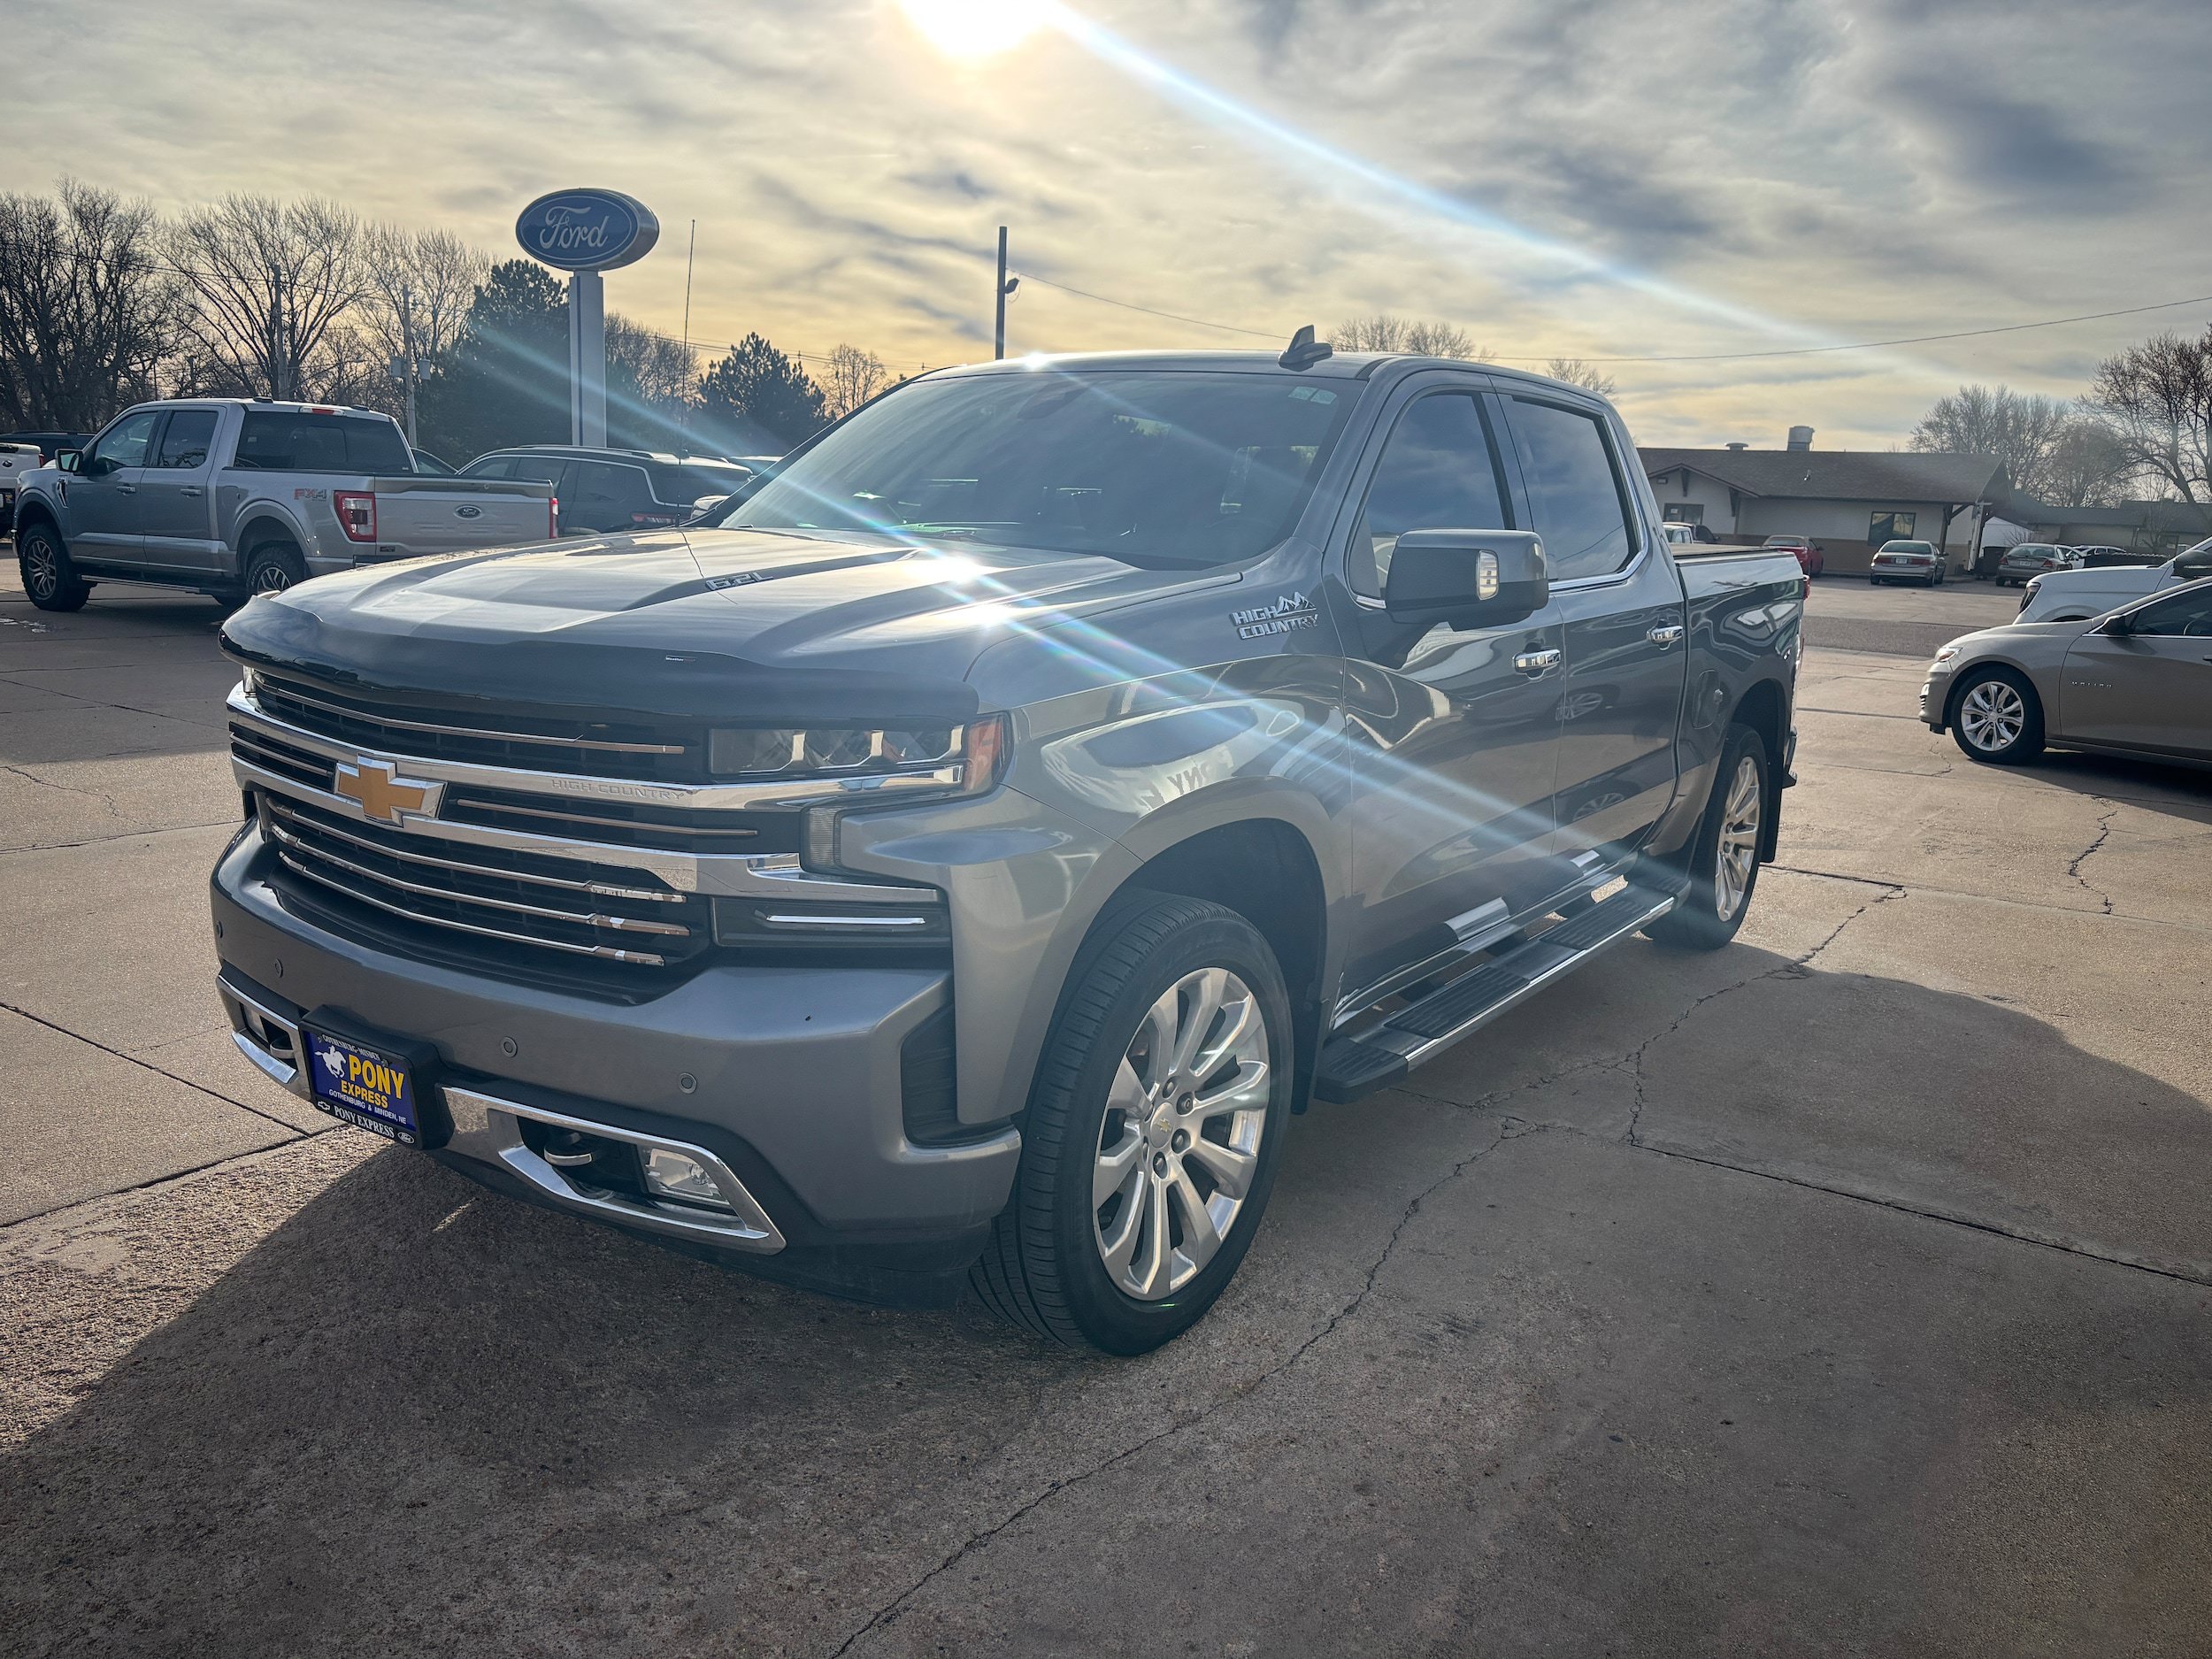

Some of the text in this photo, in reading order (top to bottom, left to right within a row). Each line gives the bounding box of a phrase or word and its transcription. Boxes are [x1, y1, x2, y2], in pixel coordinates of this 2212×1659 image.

[540, 206, 610, 249] Ford
[294, 488, 327, 501] FX4
[705, 572, 773, 591] 6.2L
[1231, 605, 1279, 625] HIGH
[1238, 614, 1318, 639] COUNTRY
[551, 780, 685, 800] HIGH COUNTRY
[348, 1054, 404, 1100] PONY
[328, 1088, 365, 1110] GOTHENBURG
[398, 1115, 406, 1125] NE
[341, 1079, 388, 1109] EXPRESS
[334, 1105, 395, 1138] PONY EXPRESS
